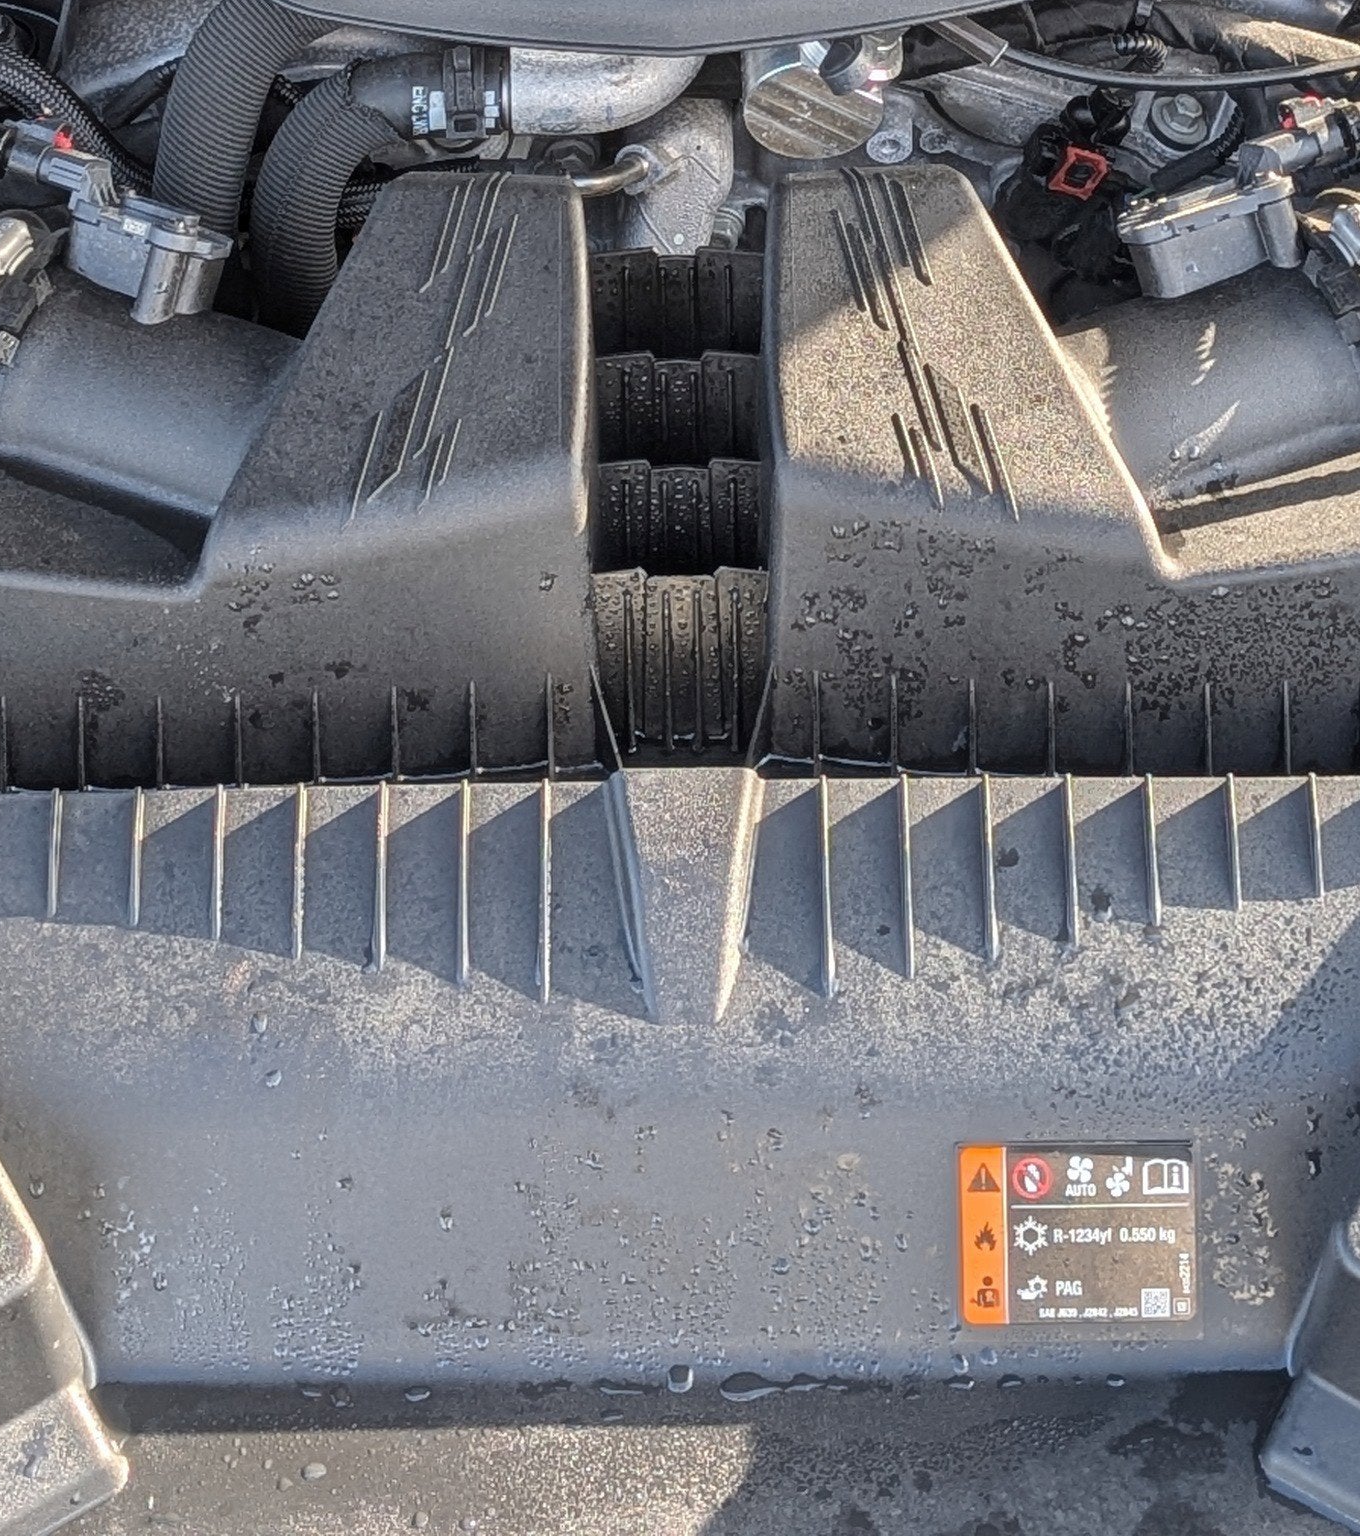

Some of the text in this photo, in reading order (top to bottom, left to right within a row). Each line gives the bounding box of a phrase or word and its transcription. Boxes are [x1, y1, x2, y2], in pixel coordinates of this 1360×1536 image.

[1065, 1183, 1097, 1197] AUTO
[1119, 1227, 1156, 1243] 0.550
[1159, 1227, 1176, 1244] kg
[1055, 1281, 1083, 1296] PAG
